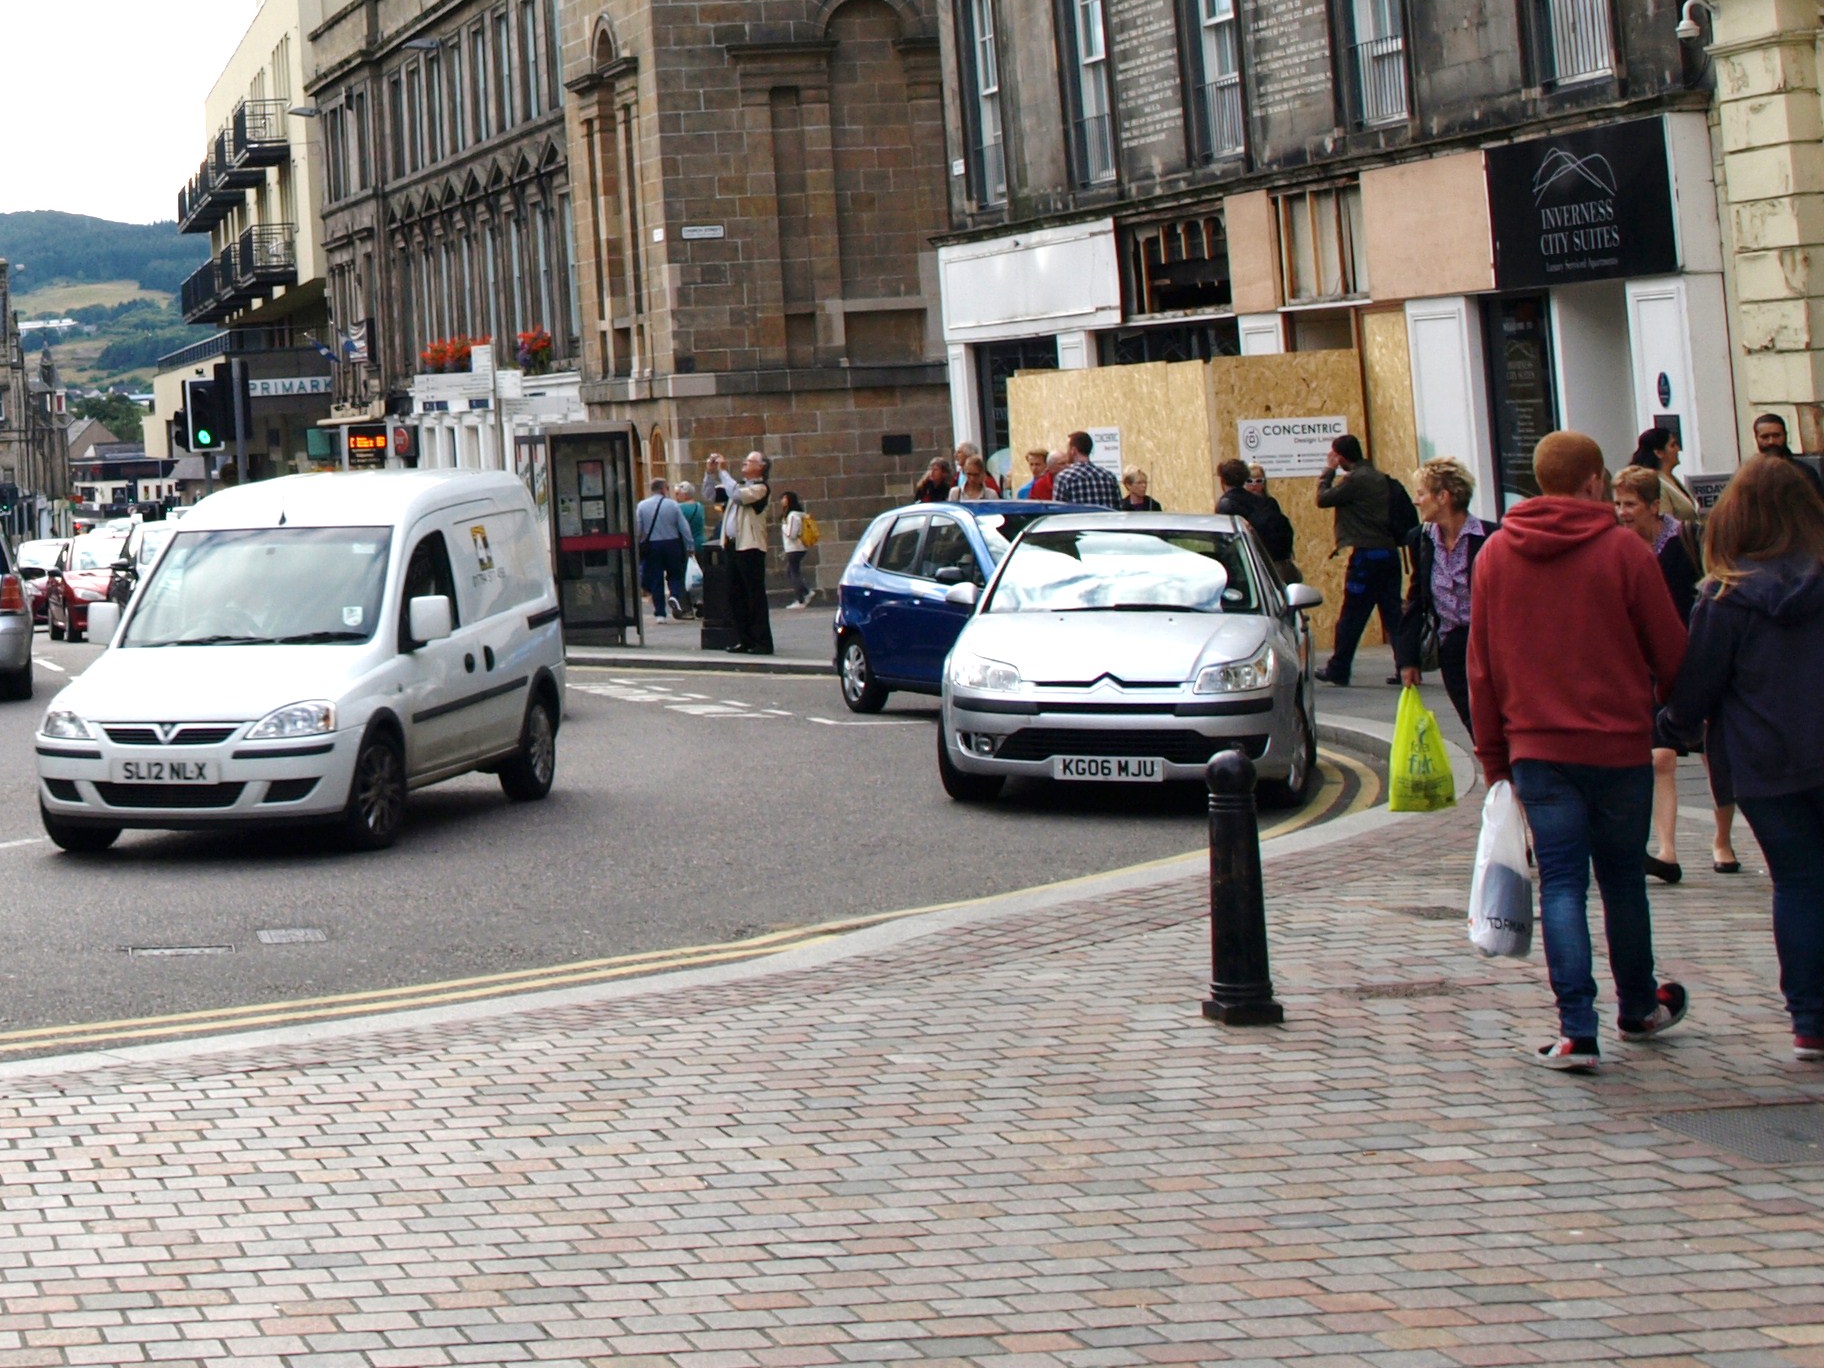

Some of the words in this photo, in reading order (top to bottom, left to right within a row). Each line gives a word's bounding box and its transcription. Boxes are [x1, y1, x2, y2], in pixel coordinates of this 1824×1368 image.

[1540, 198, 1614, 230] INVERNESS
[1540, 231, 1569, 256] CITY
[1572, 224, 1620, 252] SUITES
[249, 379, 332, 391] PRIMARK
[1262, 422, 1342, 436] CONCENTRIC
[123, 762, 164, 780] SL12
[169, 762, 207, 780] NLX
[1062, 758, 1112, 776] KG06
[1117, 759, 1155, 777] MJU
